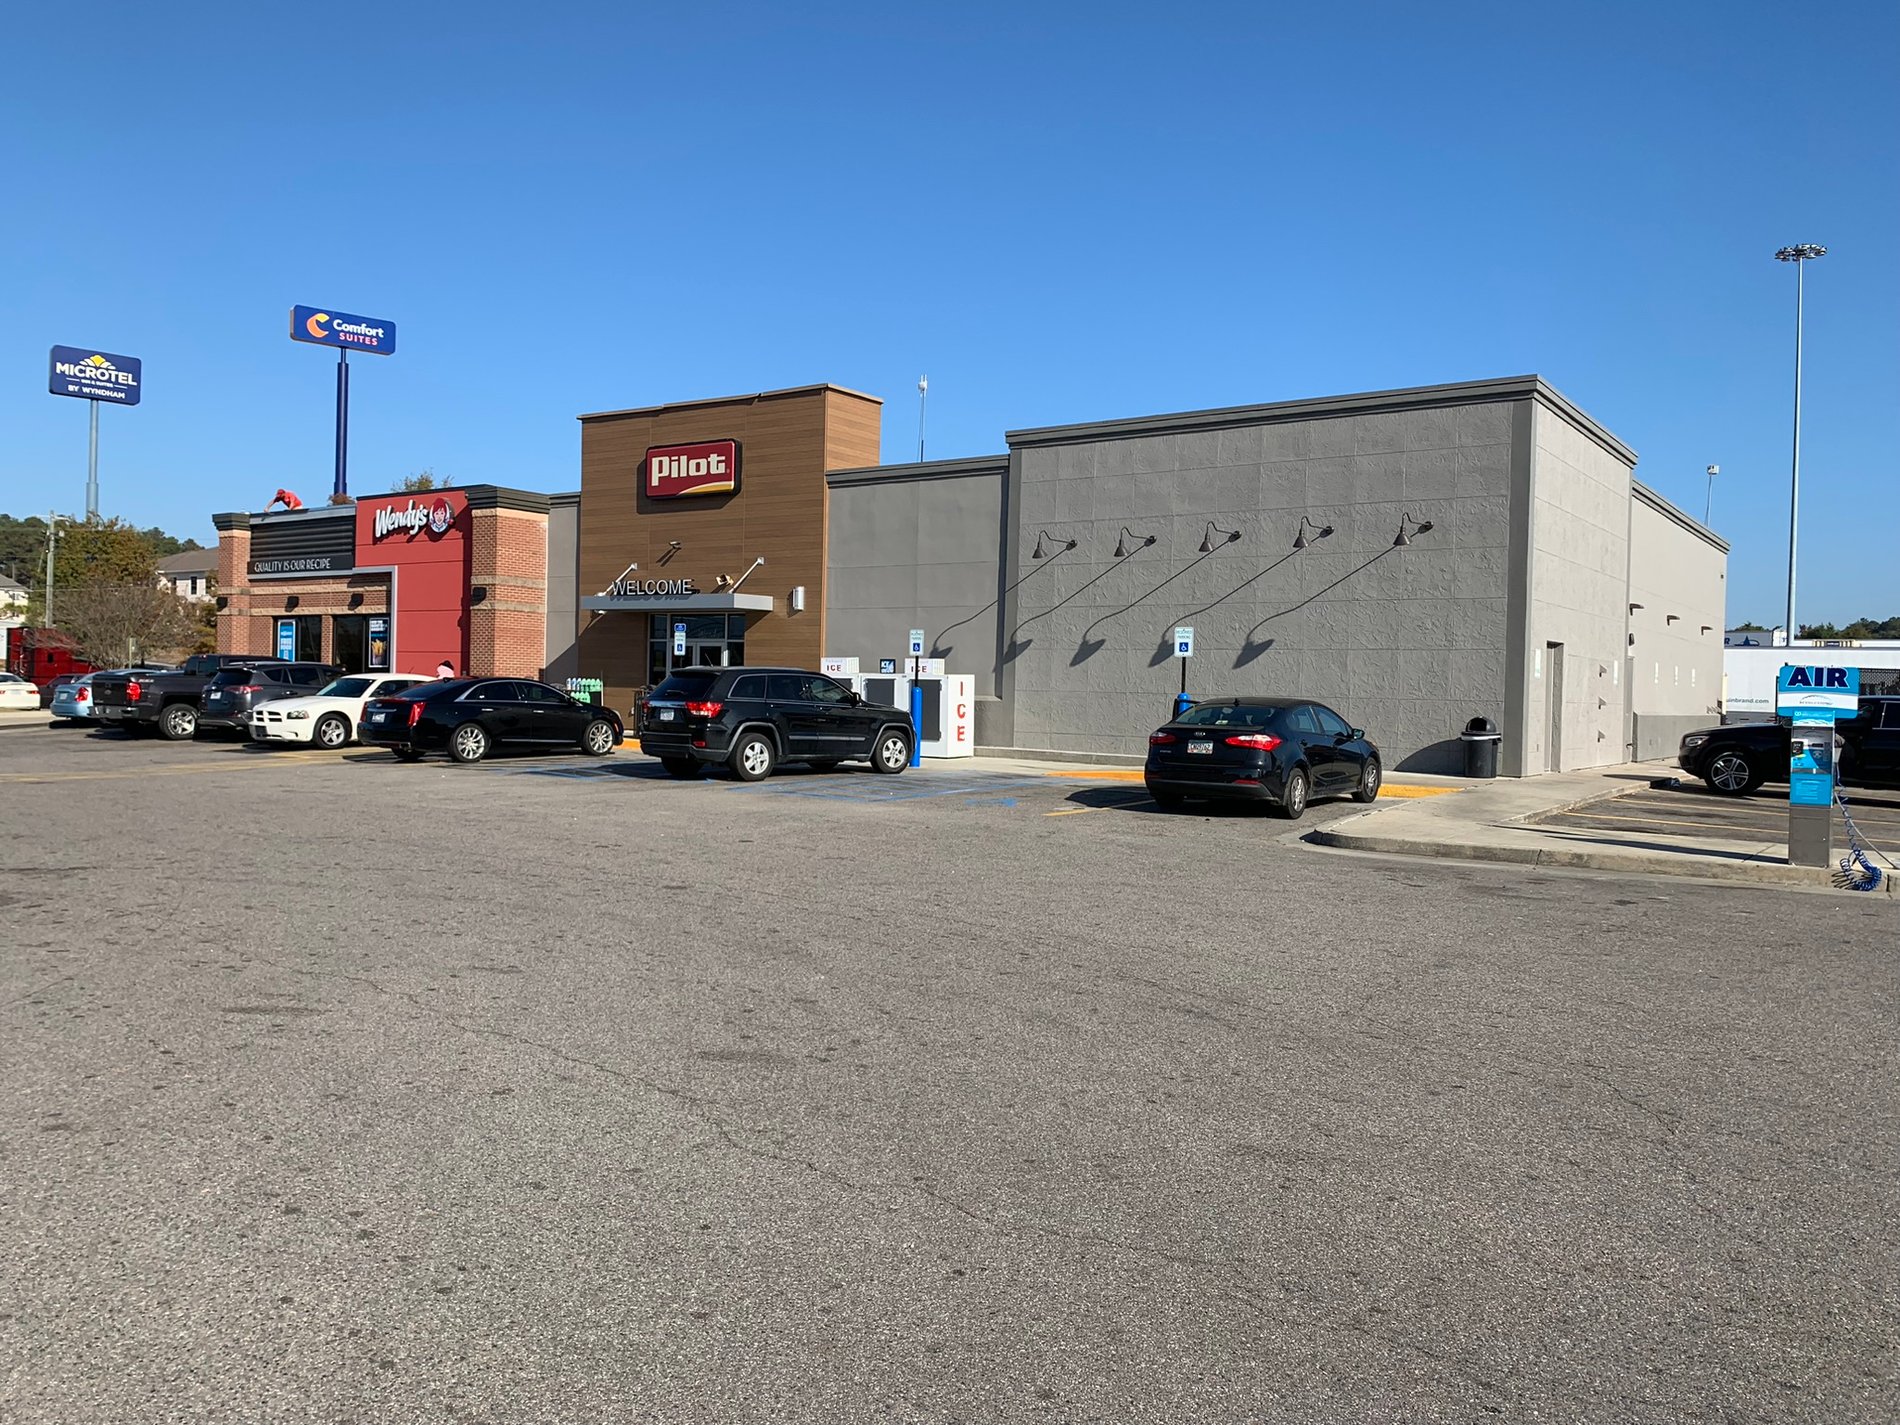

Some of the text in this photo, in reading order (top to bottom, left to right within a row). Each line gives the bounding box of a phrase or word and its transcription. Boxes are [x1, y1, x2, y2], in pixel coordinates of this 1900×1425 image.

[333, 319, 384, 337] Comfort
[339, 332, 378, 345] SUITES
[56, 362, 137, 386] MICROTEL
[67, 385, 126, 399] BY WYNDHAM
[375, 499, 429, 538] Wendy's
[254, 558, 331, 573] QUALITY IS OUR RECIPE
[612, 579, 693, 595] WELCOME
[826, 664, 842, 672] ICE
[1786, 665, 1850, 688] AIR
[956, 681, 966, 742] ICE
